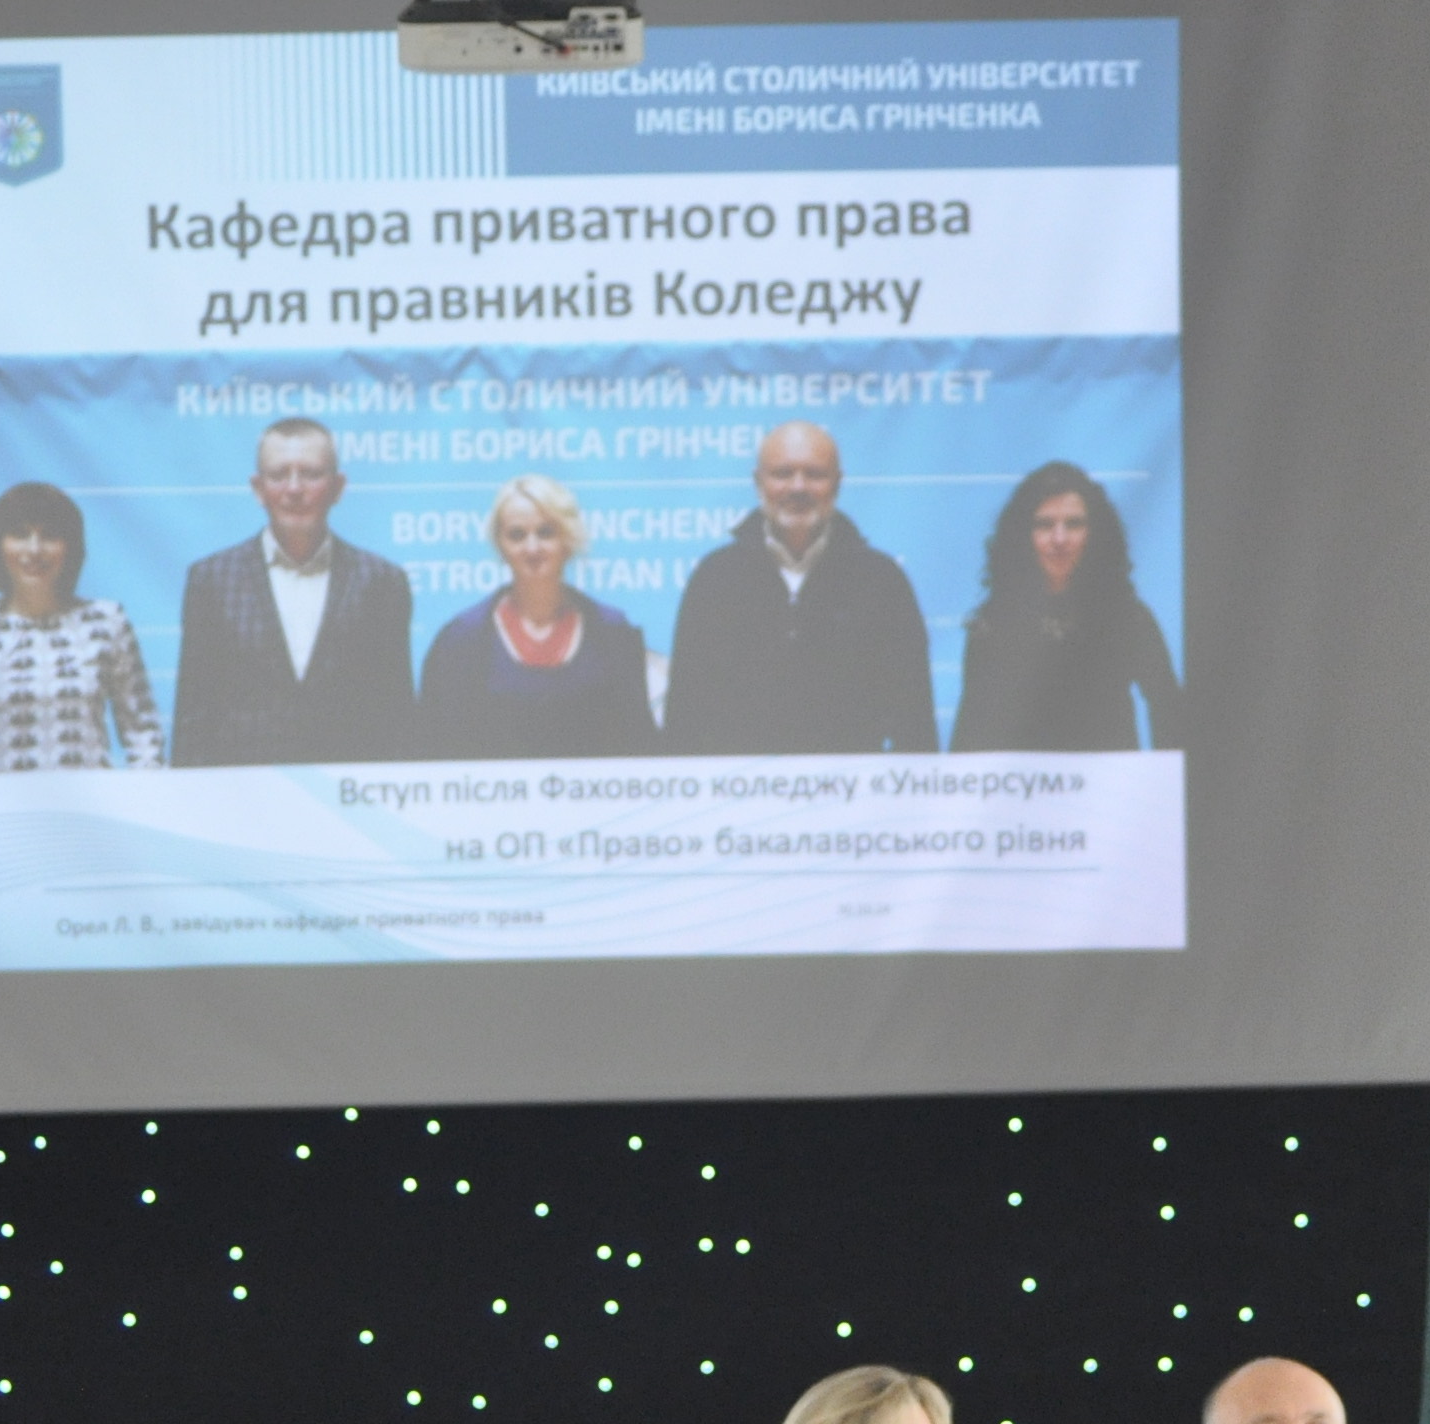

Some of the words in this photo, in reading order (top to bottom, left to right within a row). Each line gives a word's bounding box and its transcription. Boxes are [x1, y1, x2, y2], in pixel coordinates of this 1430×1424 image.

[724, 57, 920, 94] СТОЛИЧНИЙ
[925, 60, 1142, 90] УНІВЕРСИТЕТ
[635, 107, 726, 135] ІМЕНІ
[732, 104, 860, 134] БОРИСА
[865, 100, 1043, 131] ГРІНЧЕНКА
[147, 200, 411, 260] Кафедра
[433, 202, 777, 255] приватного
[797, 199, 972, 249] права
[199, 289, 309, 336] для
[330, 271, 634, 334] правників
[654, 270, 923, 326] Коледжу
[176, 373, 417, 417] КИЇВСЬКИЙ
[429, 368, 690, 414] СТОЛИЧНИЙ
[702, 370, 992, 407] УНІВЕРСИТЕТ
[333, 430, 439, 463] МЕНІ
[450, 426, 606, 463] БОРИСА
[340, 778, 430, 810] Вступ
[445, 777, 527, 802] після
[540, 774, 700, 801] Фахового
[711, 772, 858, 802] коледжу
[870, 766, 1086, 800] «Універсум»
[446, 839, 485, 861] на
[495, 831, 546, 860] ОП
[558, 830, 703, 862] «Право»
[715, 827, 985, 857] бакалаврського
[996, 823, 1088, 857] рівня
